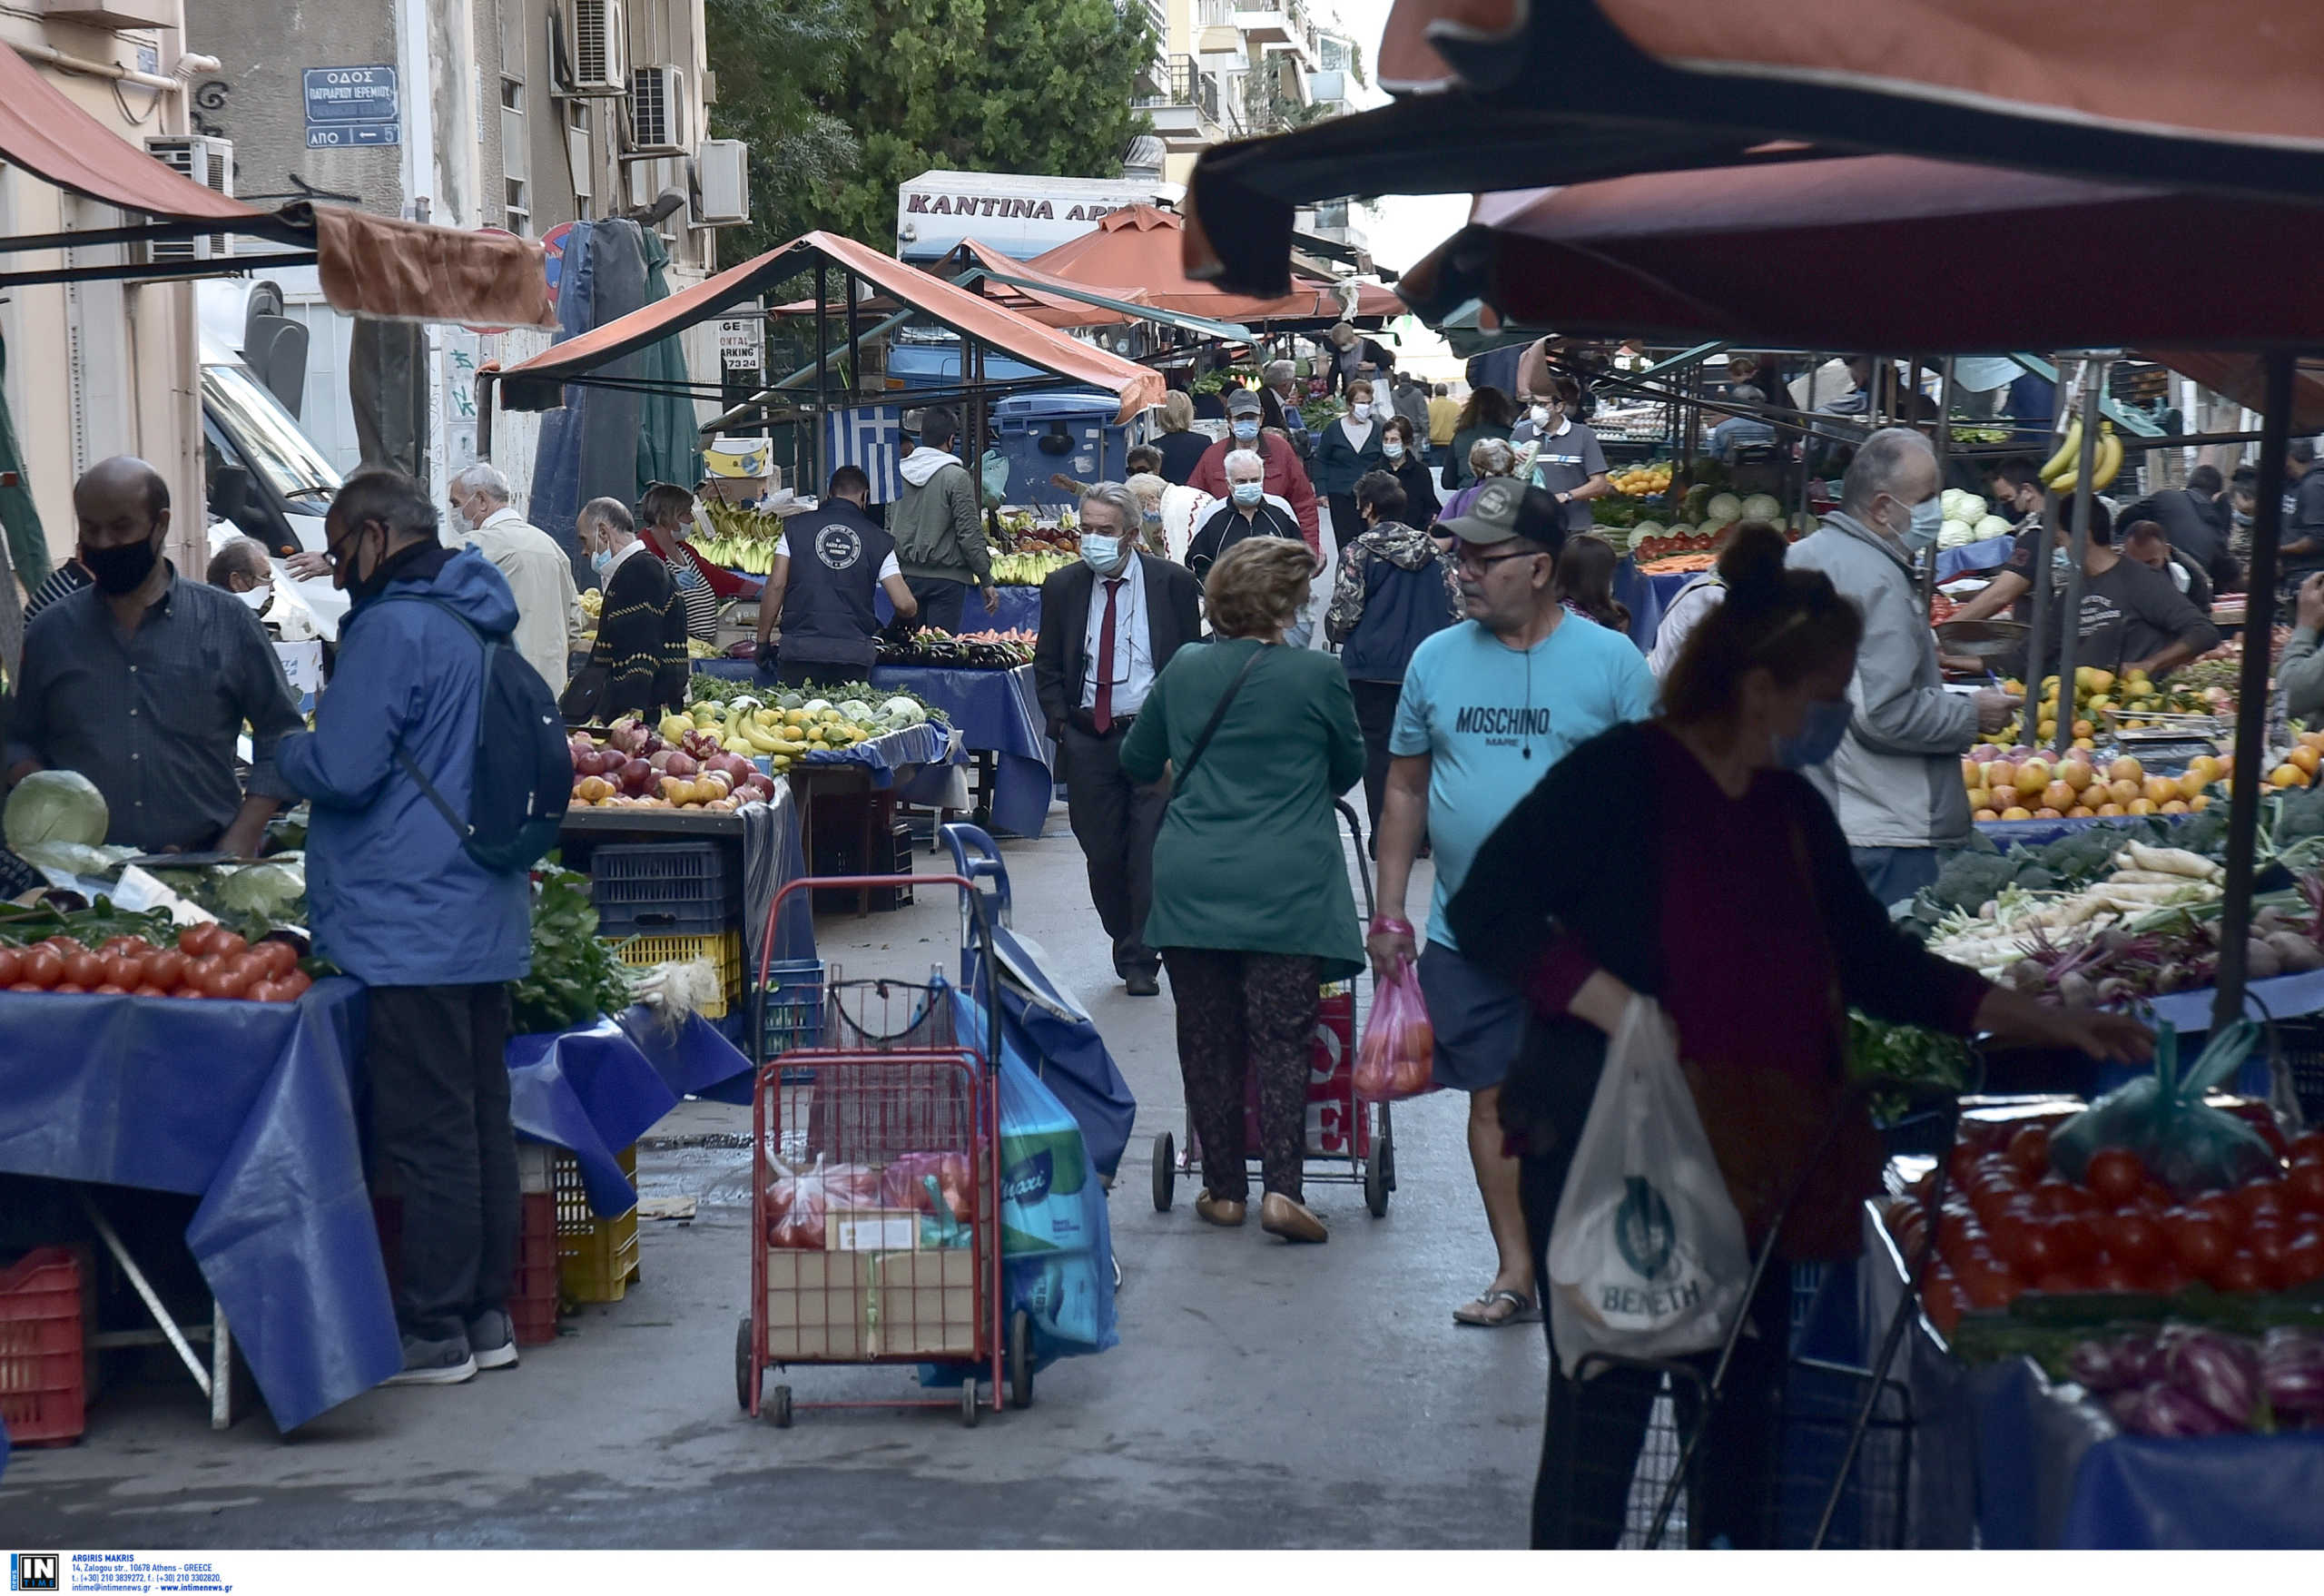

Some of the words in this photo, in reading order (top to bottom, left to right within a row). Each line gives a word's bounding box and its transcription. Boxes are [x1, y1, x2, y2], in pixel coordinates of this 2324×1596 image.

[327, 72, 374, 84] ΟΔΟΣ
[310, 132, 339, 144] ΑΠΟ
[721, 348, 753, 357] ARKING
[1455, 706, 1551, 735] MOSCHINO
